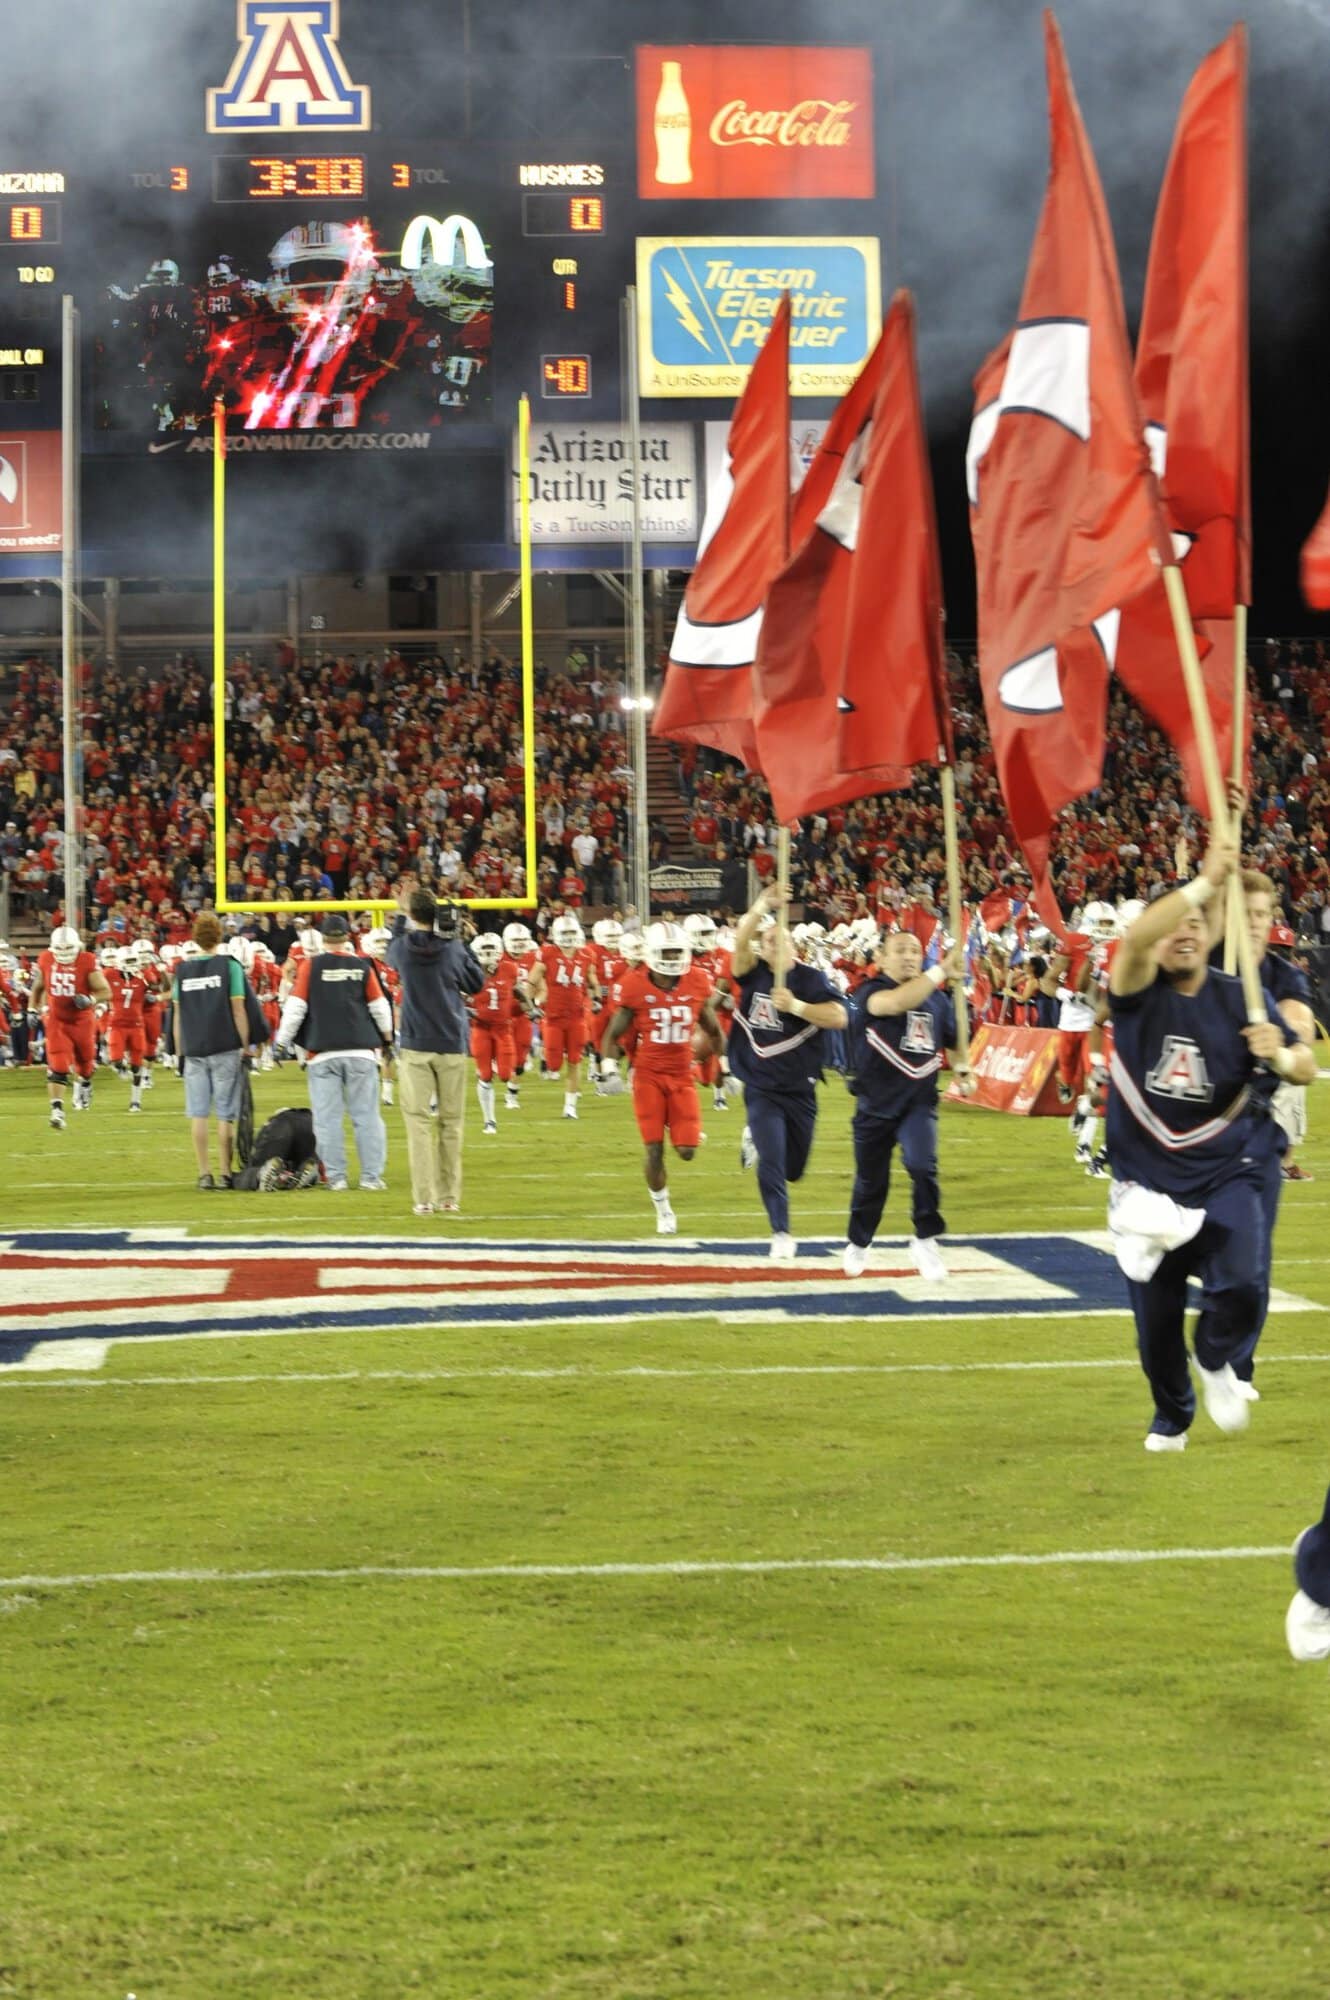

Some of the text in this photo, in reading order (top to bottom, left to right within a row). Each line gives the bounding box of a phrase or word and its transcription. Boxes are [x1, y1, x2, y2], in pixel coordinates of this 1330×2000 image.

[206, 0, 370, 133] A
[709, 99, 858, 146] Coca-Cola
[170, 167, 188, 190] 3
[250, 159, 363, 195] 3:38
[393, 164, 410, 187] 3
[414, 168, 449, 184] TOL
[520, 164, 604, 185] HUSKIES
[17, 266, 55, 283] TO GO
[704, 260, 817, 290] Tucson
[544, 360, 588, 393] 40
[667, 372, 741, 387] UniSource
[186, 432, 431, 452] ARZONAWILDCATS.COM
[550, 521, 560, 532] a
[566, 516, 633, 533] Tucson
[51, 973, 76, 996] 55
[181, 975, 222, 991] ESPN
[321, 968, 365, 982] ESPN
[556, 965, 584, 988] 44
[121, 988, 134, 1009] 7
[487, 988, 499, 1010] 1
[649, 1005, 693, 1044] 32
[1145, 1034, 1214, 1103] A
